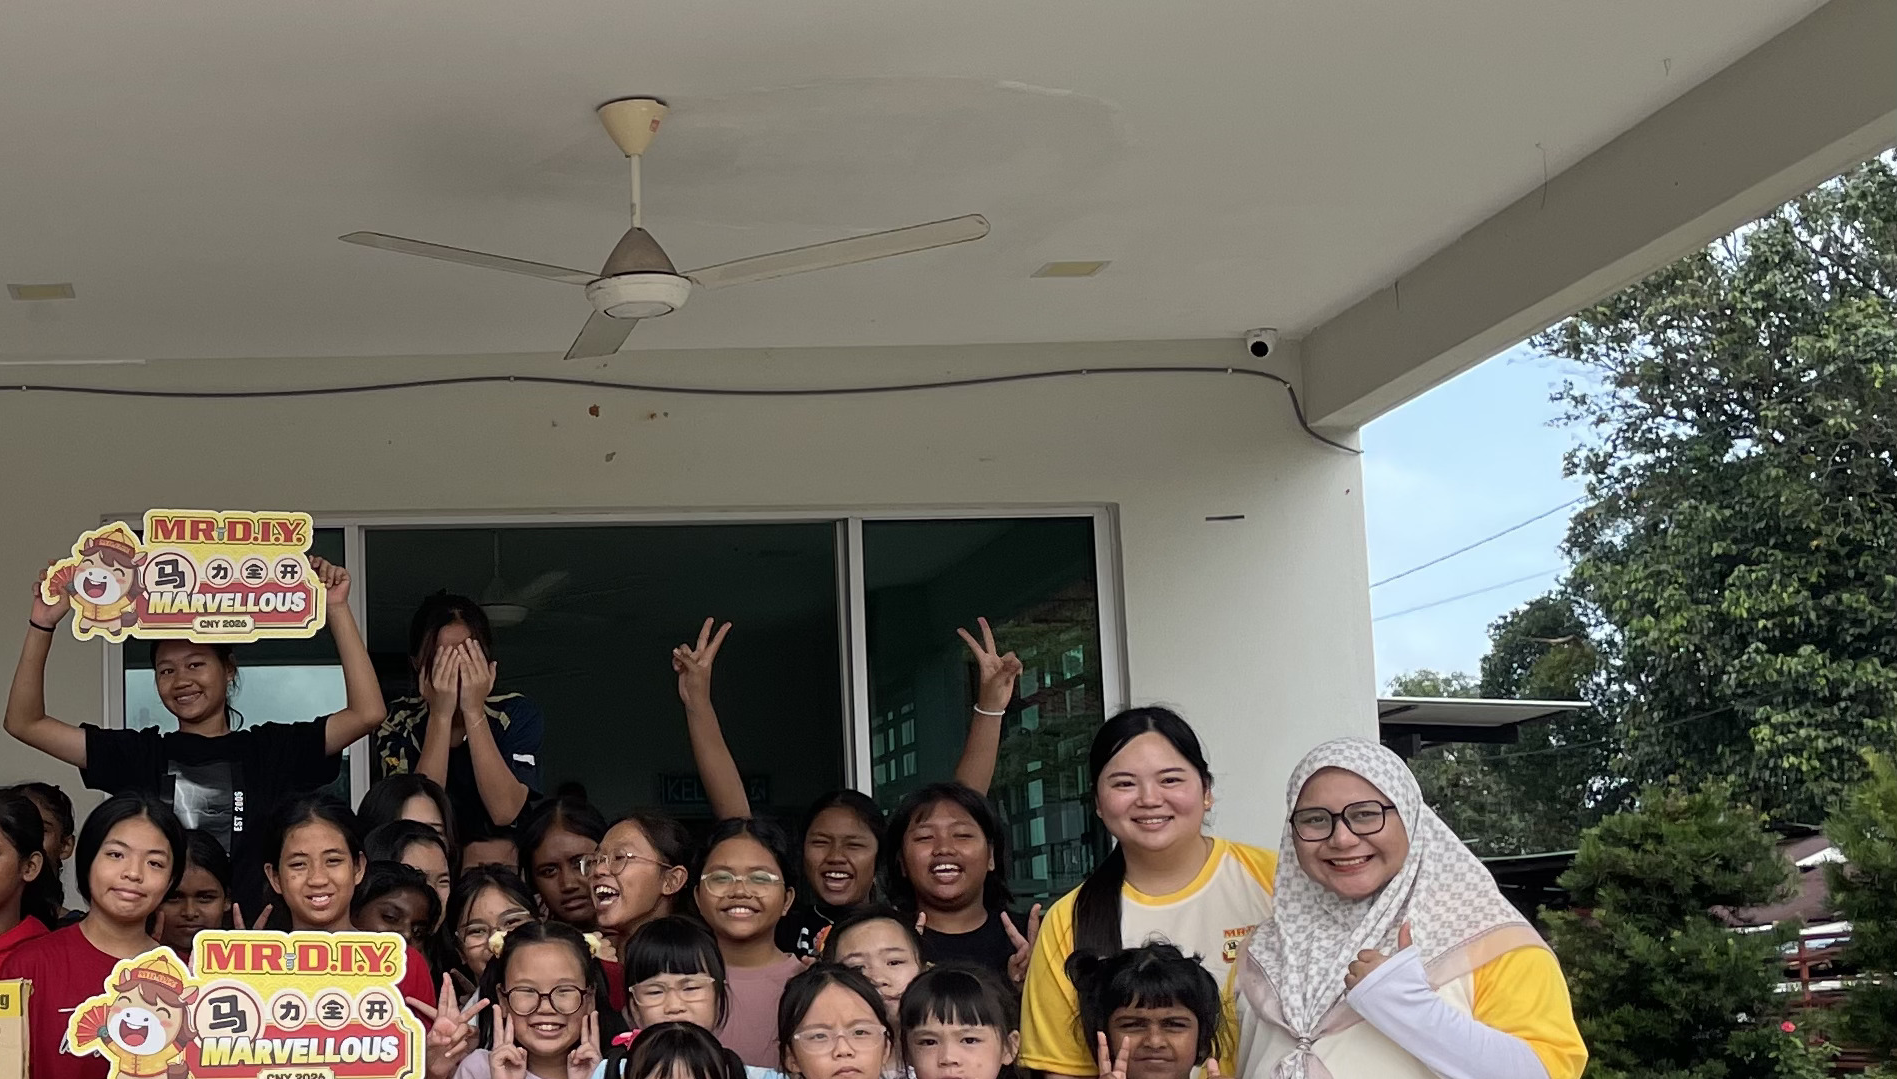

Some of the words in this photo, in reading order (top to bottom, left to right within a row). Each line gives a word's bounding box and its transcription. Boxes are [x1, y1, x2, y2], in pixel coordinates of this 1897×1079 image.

[154, 559, 300, 589] 马力全开
[148, 591, 307, 614] MARVELLOUS
[199, 620, 221, 629] CNY
[208, 994, 389, 1034] 马力全开
[201, 1036, 400, 1067] MARVELLOUS
